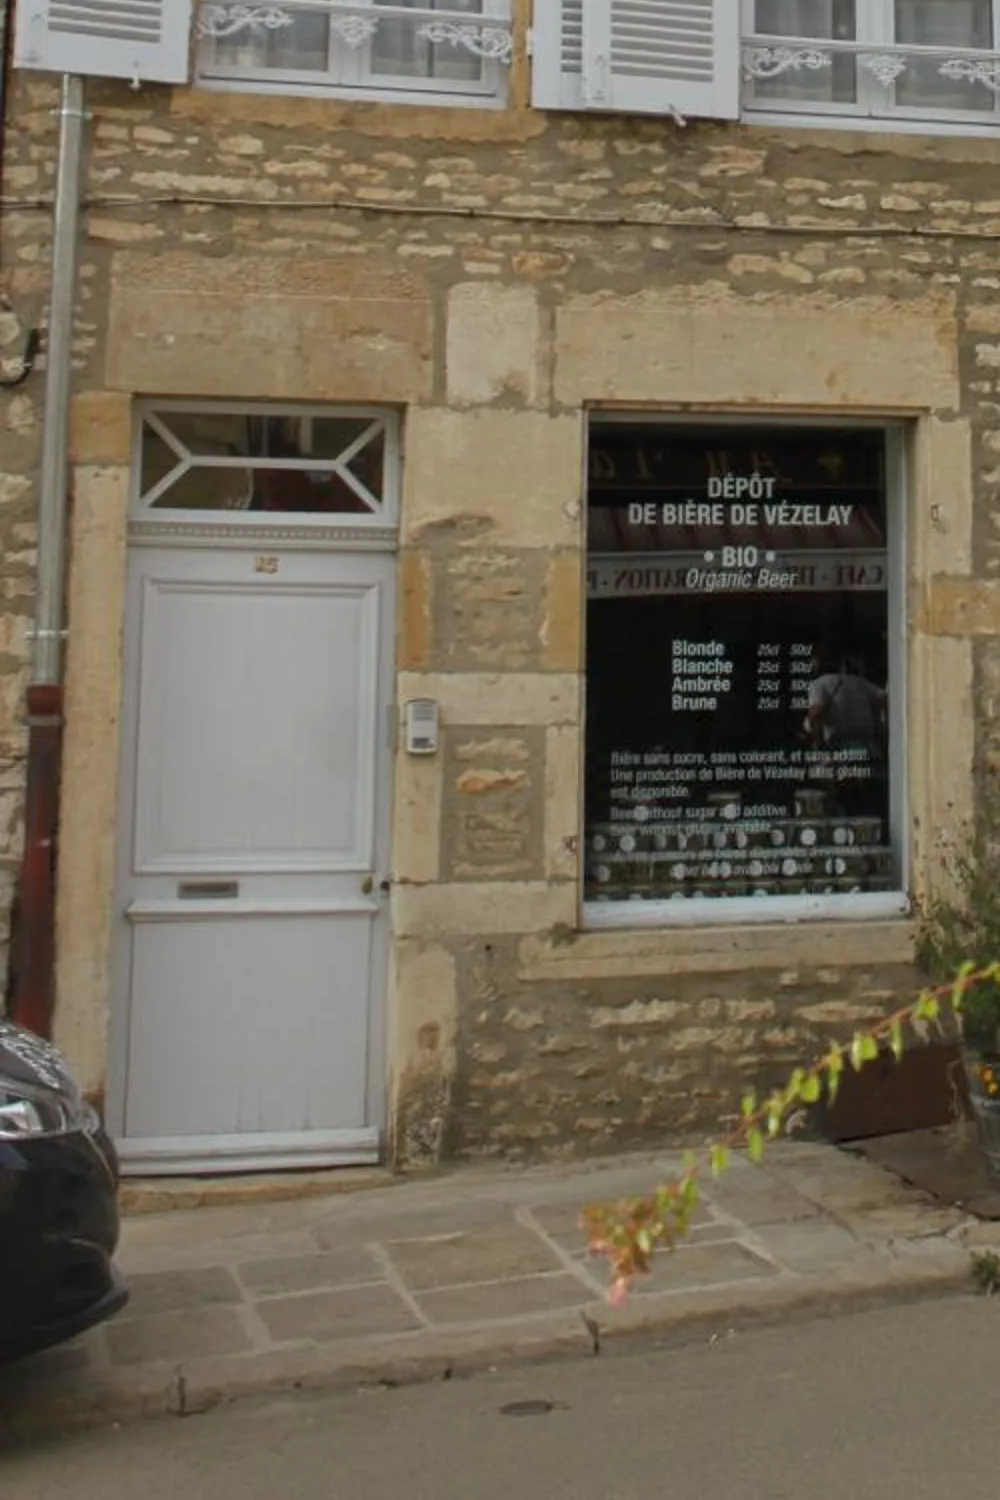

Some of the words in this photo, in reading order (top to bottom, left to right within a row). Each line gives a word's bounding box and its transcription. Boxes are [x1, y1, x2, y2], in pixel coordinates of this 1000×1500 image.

[708, 471, 777, 499] DÉPÔT
[628, 503, 657, 525] DE
[663, 499, 724, 525] BIÈRE
[730, 503, 759, 525] DE
[764, 499, 854, 526] VÉZELAY
[721, 546, 758, 568] BIO
[686, 567, 752, 593] Organic
[757, 568, 799, 588] Beer
[672, 639, 725, 657] Blonde
[672, 659, 734, 675] Blanche
[672, 676, 732, 692] Ambrée
[672, 694, 718, 711] Brune
